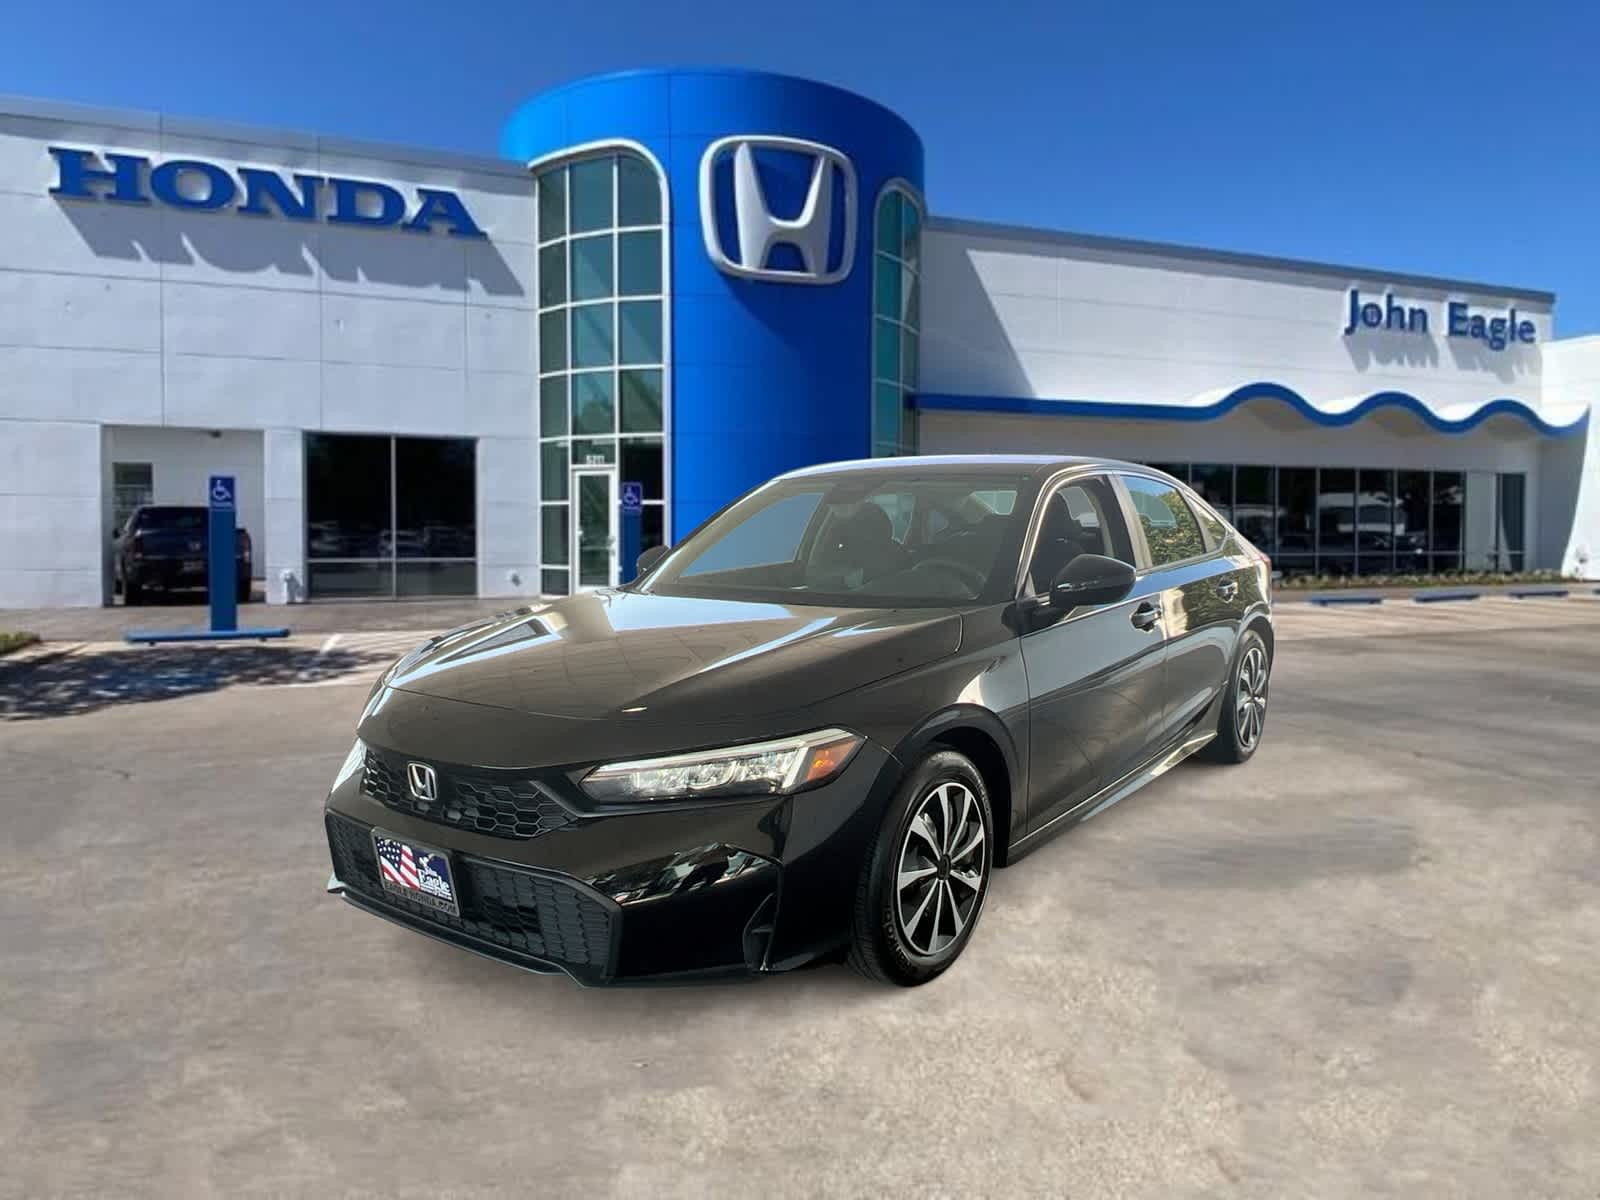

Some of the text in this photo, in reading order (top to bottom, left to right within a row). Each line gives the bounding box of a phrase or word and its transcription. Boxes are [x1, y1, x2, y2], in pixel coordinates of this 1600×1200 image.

[47, 145, 490, 238] HONDA
[1344, 287, 1537, 351] John Eagle
